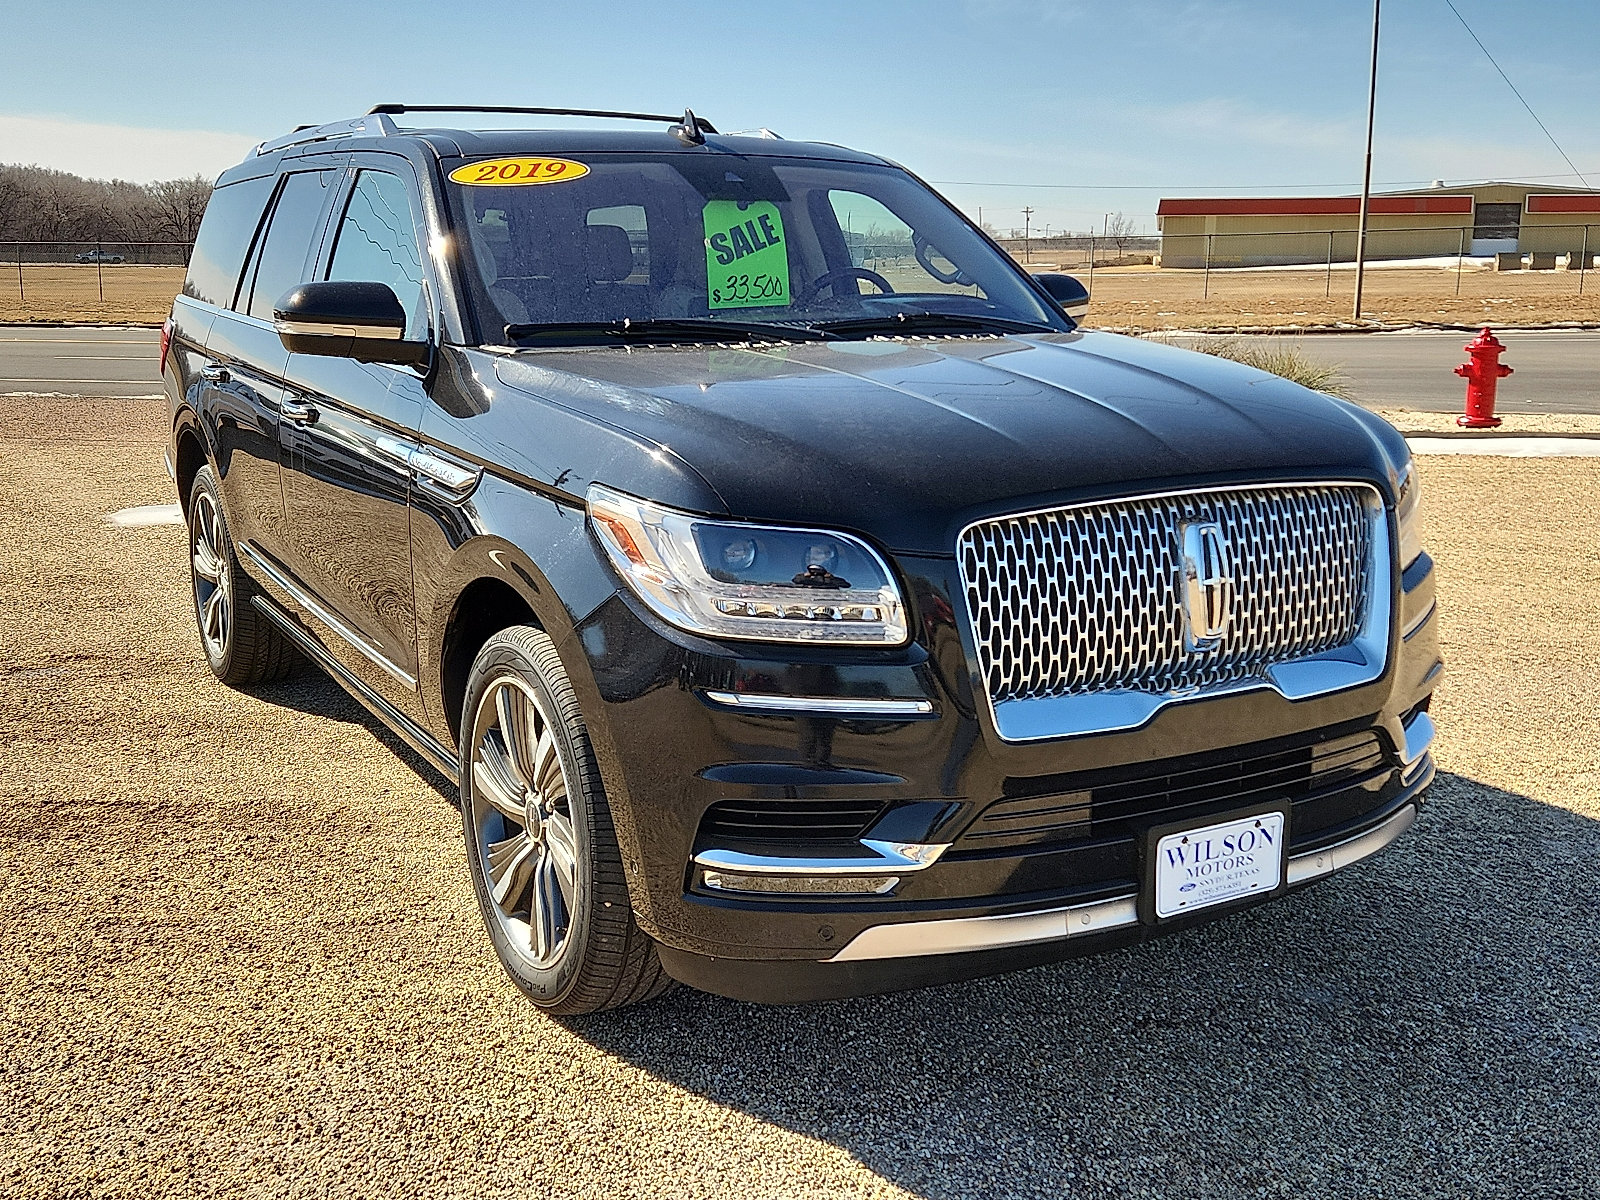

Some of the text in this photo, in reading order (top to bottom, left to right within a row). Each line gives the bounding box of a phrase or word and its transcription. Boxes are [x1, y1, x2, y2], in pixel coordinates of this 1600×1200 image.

[474, 162, 567, 181] 2019
[710, 213, 781, 266] SALE
[1166, 825, 1276, 869] WILSON
[1186, 852, 1255, 880] MOTORS
